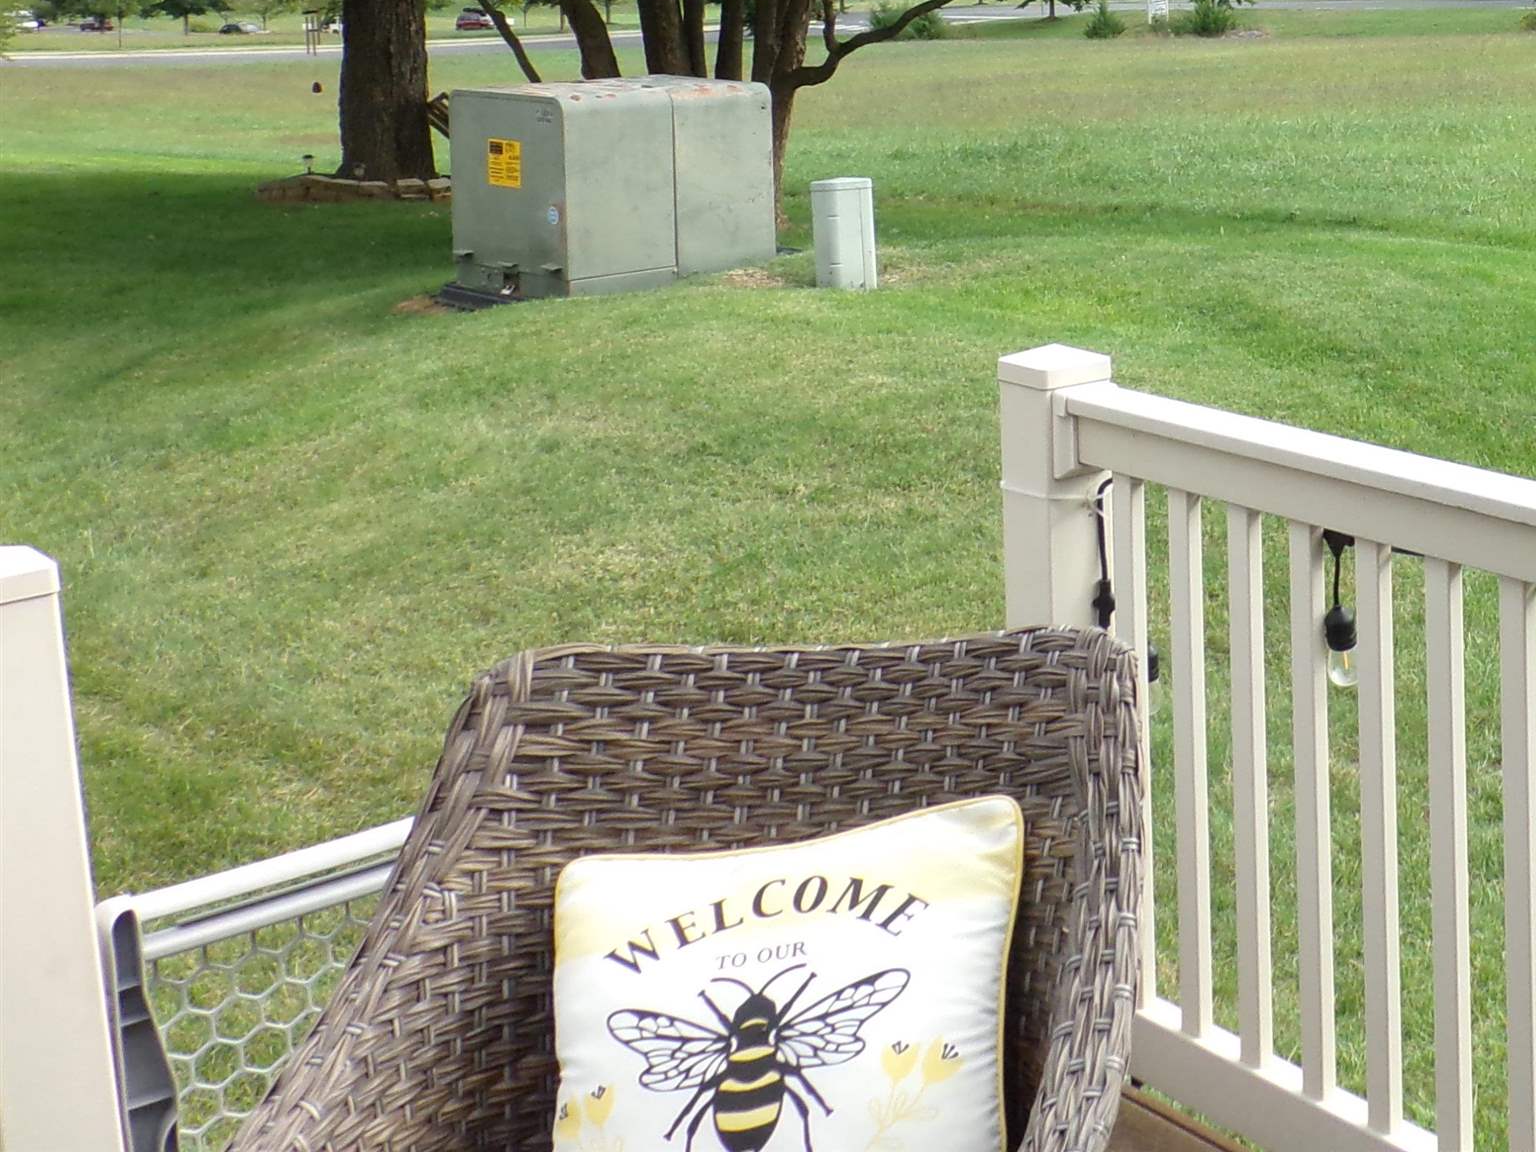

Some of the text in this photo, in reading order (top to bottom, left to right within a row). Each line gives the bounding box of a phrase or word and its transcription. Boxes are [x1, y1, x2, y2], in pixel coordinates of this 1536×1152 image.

[604, 875, 929, 973] WELCOME
[716, 941, 807, 970] TO OUR
